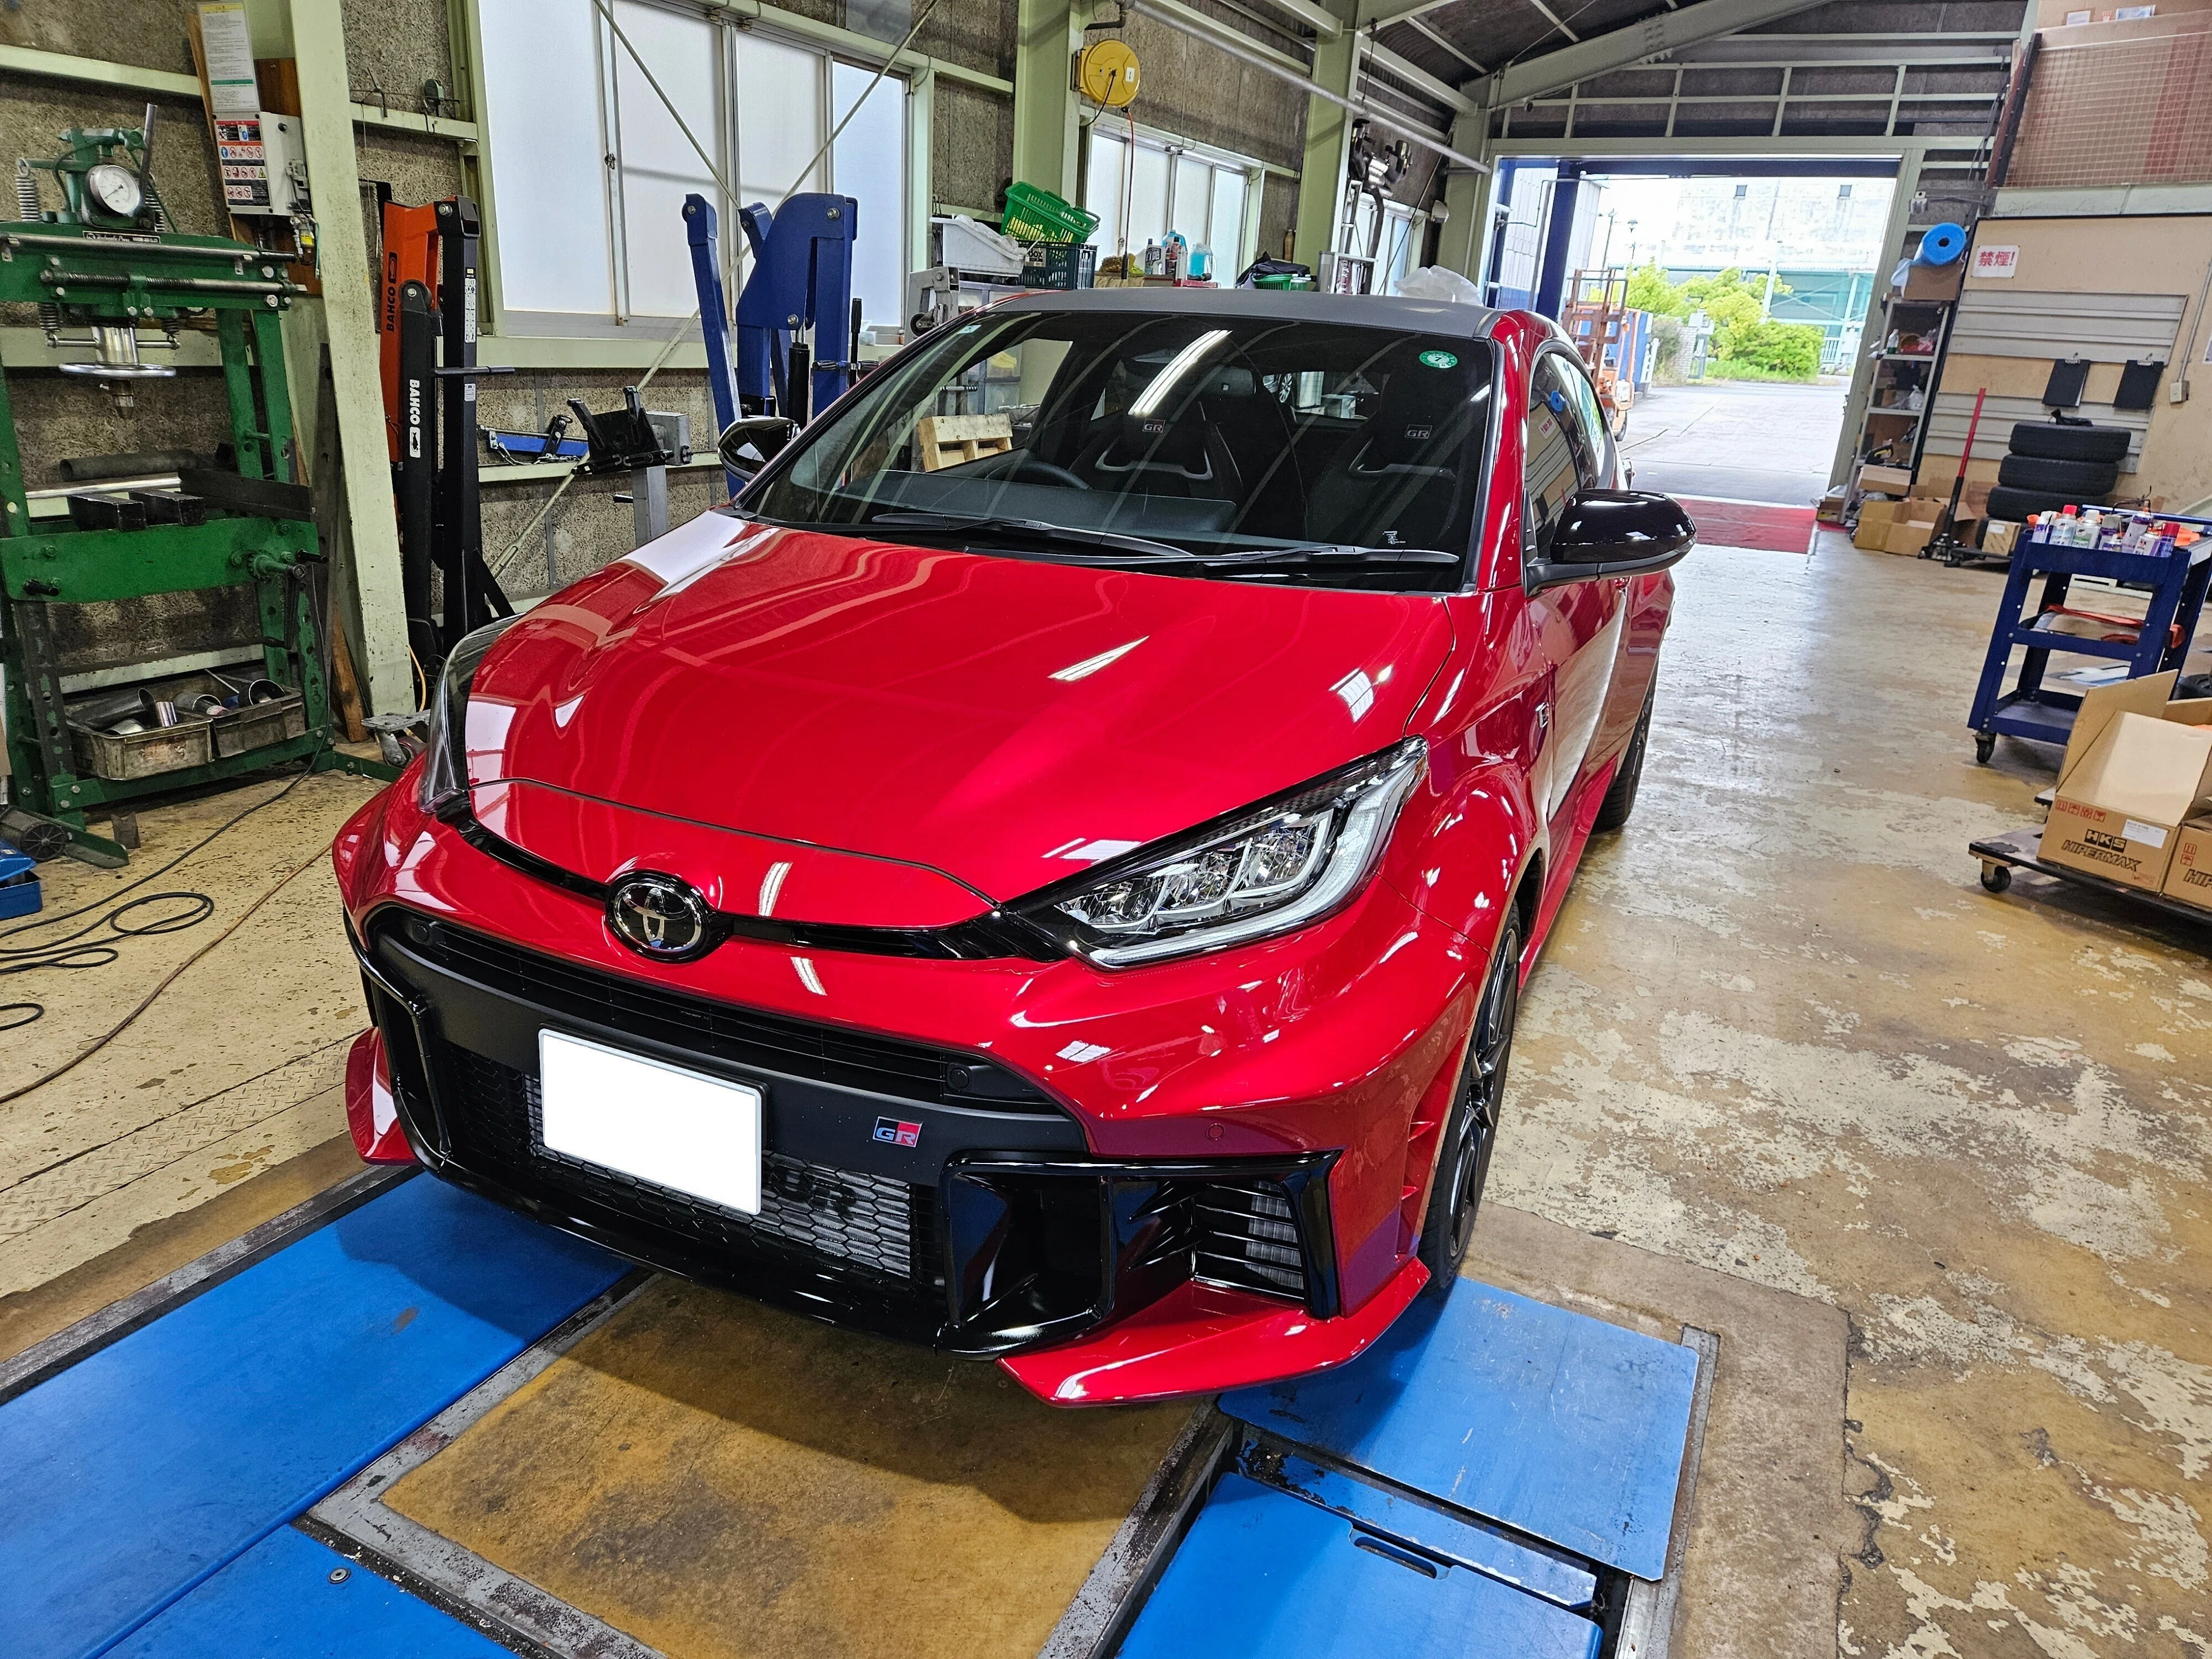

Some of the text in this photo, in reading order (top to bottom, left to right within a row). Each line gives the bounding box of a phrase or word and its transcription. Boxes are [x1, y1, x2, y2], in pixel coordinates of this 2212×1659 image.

[1978, 251, 2015, 266] 禁煙!
[387, 286, 396, 332] BAHCO
[410, 379, 420, 425] BAHCO
[2085, 829, 2127, 853] HKS
[2061, 839, 2142, 872] HIPERMAX
[2183, 868, 2212, 889] HIP
[876, 1126, 916, 1145] GR
